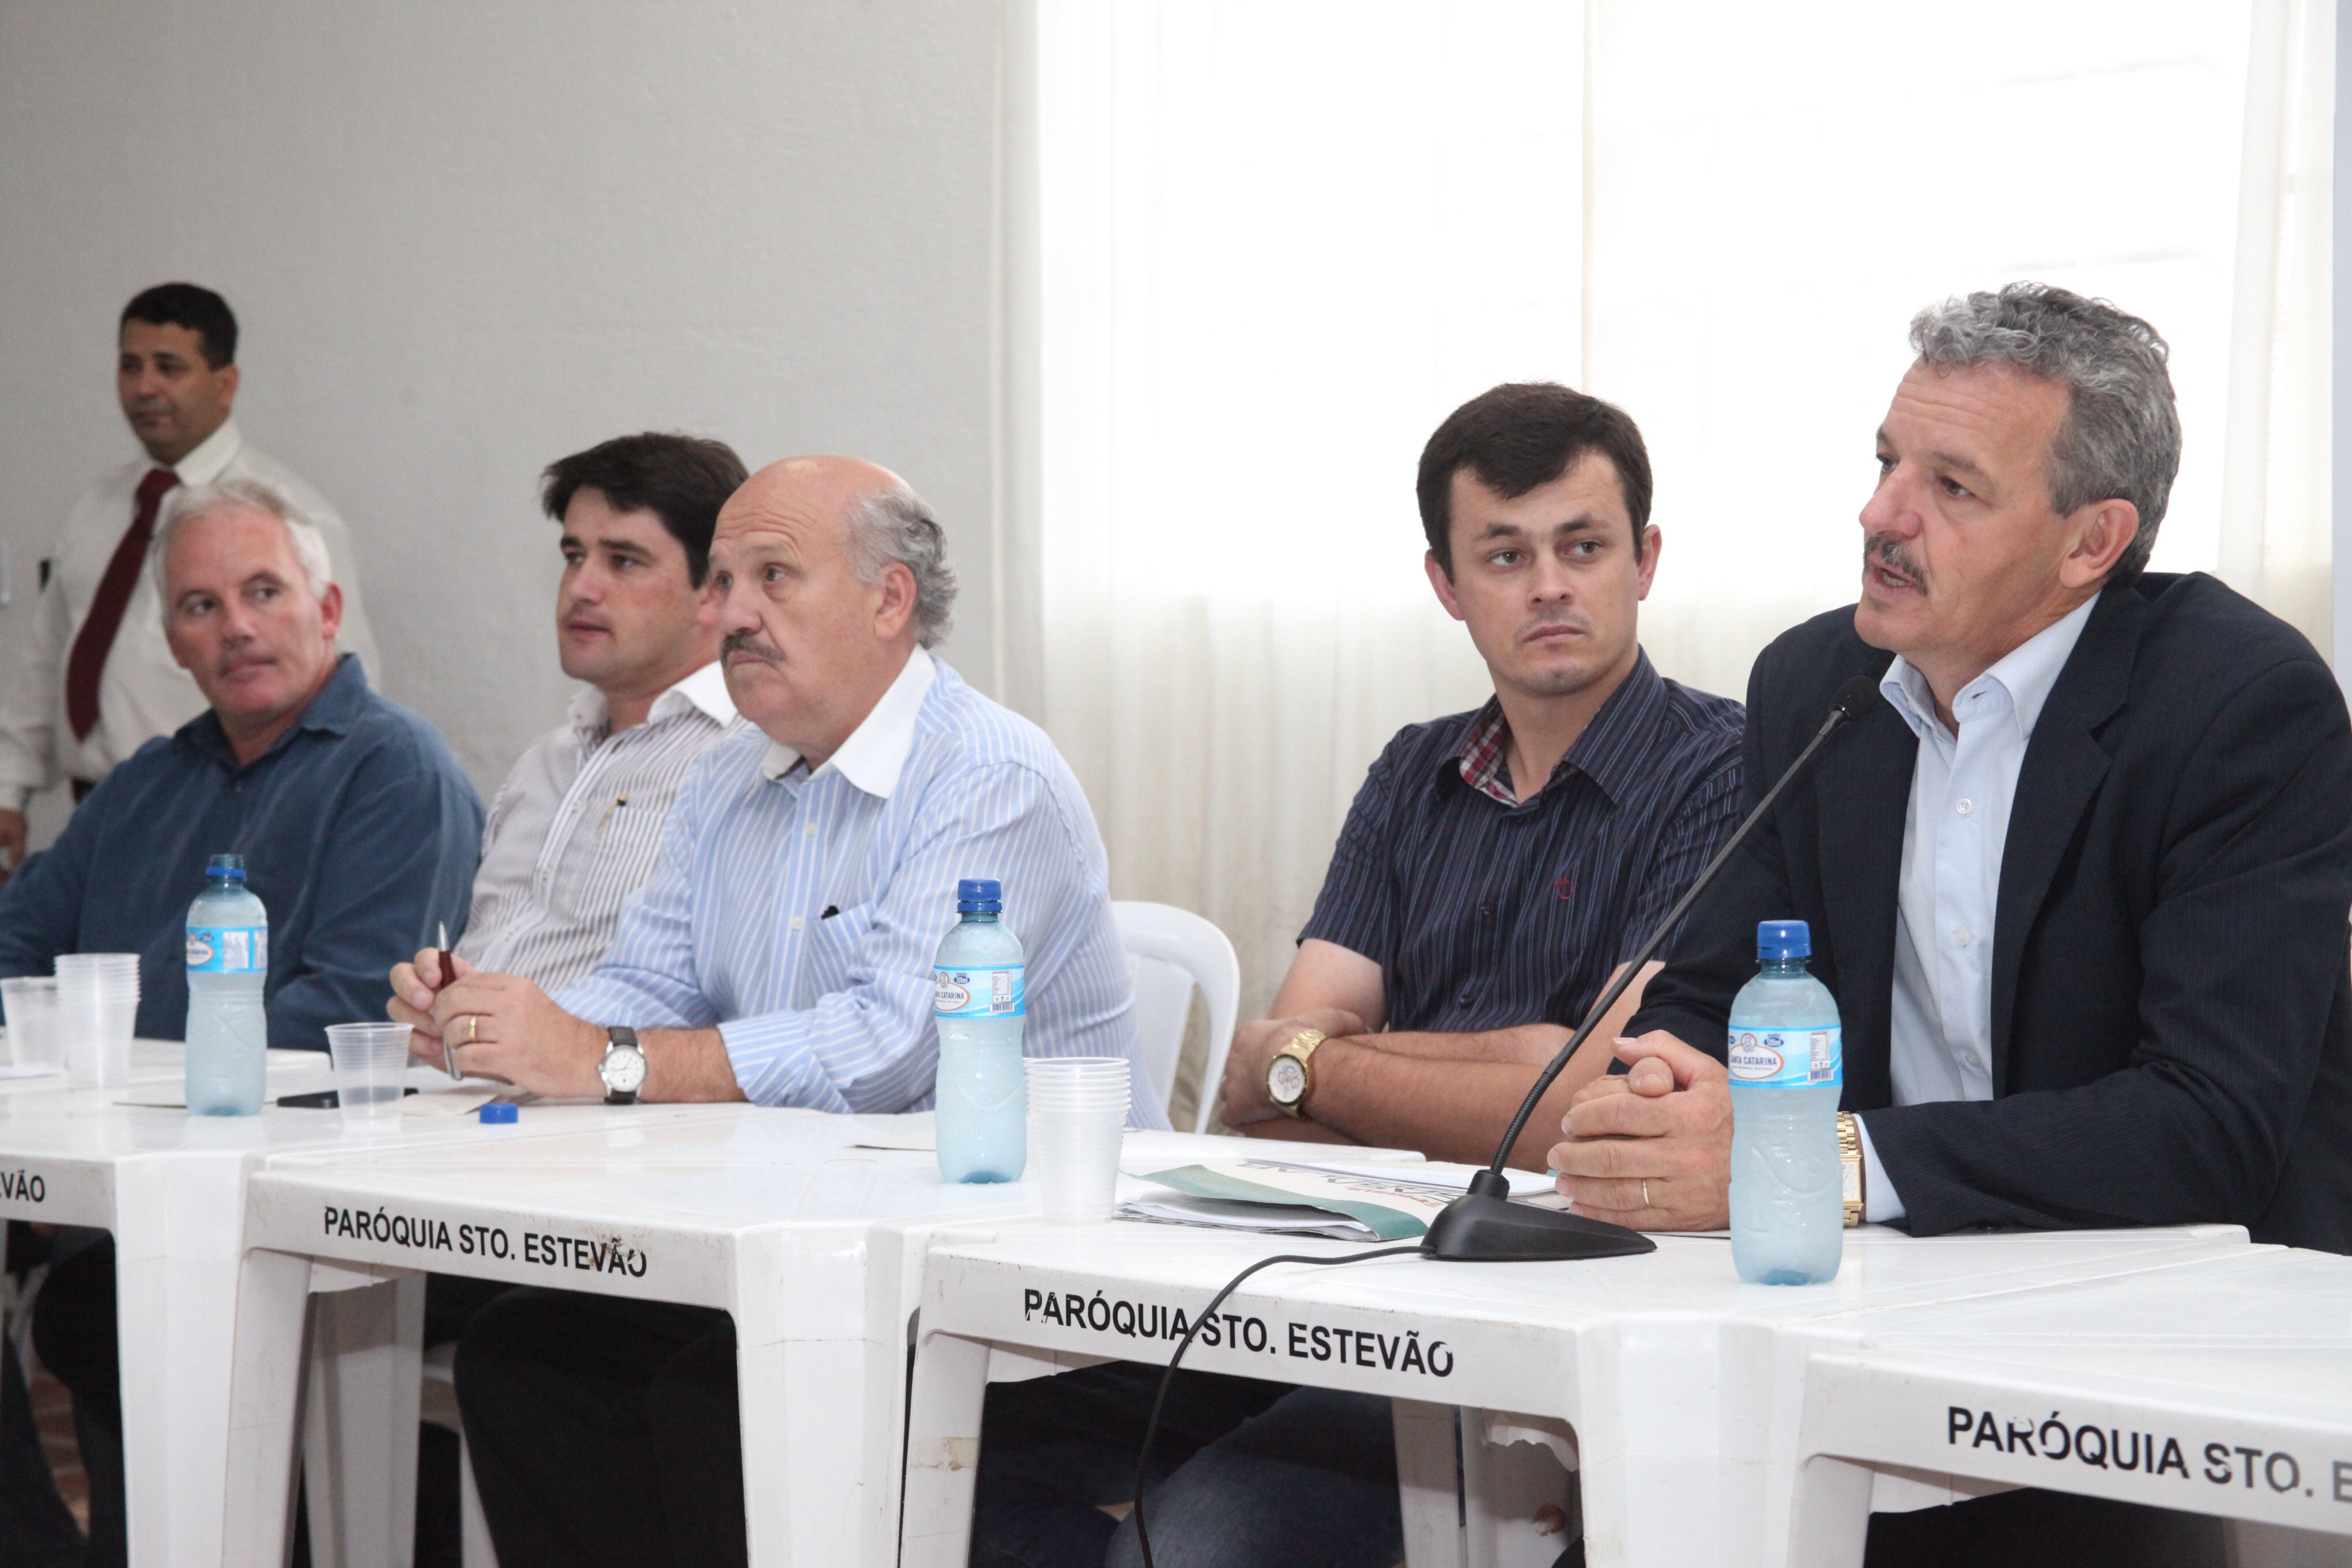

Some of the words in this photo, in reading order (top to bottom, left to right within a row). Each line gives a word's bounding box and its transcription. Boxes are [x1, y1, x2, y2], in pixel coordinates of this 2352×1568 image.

[940, 992, 965, 1000] CATARINA
[1743, 1057, 1778, 1065] CATARINA
[0, 1169, 46, 1203] VÃO
[325, 1207, 453, 1250] PARÓQUIA
[459, 1224, 515, 1260] STO.
[525, 1232, 647, 1277] ESTEVÃO
[1025, 1289, 1193, 1343] PARÓQUIA
[1201, 1311, 1276, 1354] STO.
[1288, 1322, 1454, 1377] ESTEVÃO
[1947, 1406, 2190, 1480] PARÓQUIA
[2203, 1442, 2314, 1497] STO.
